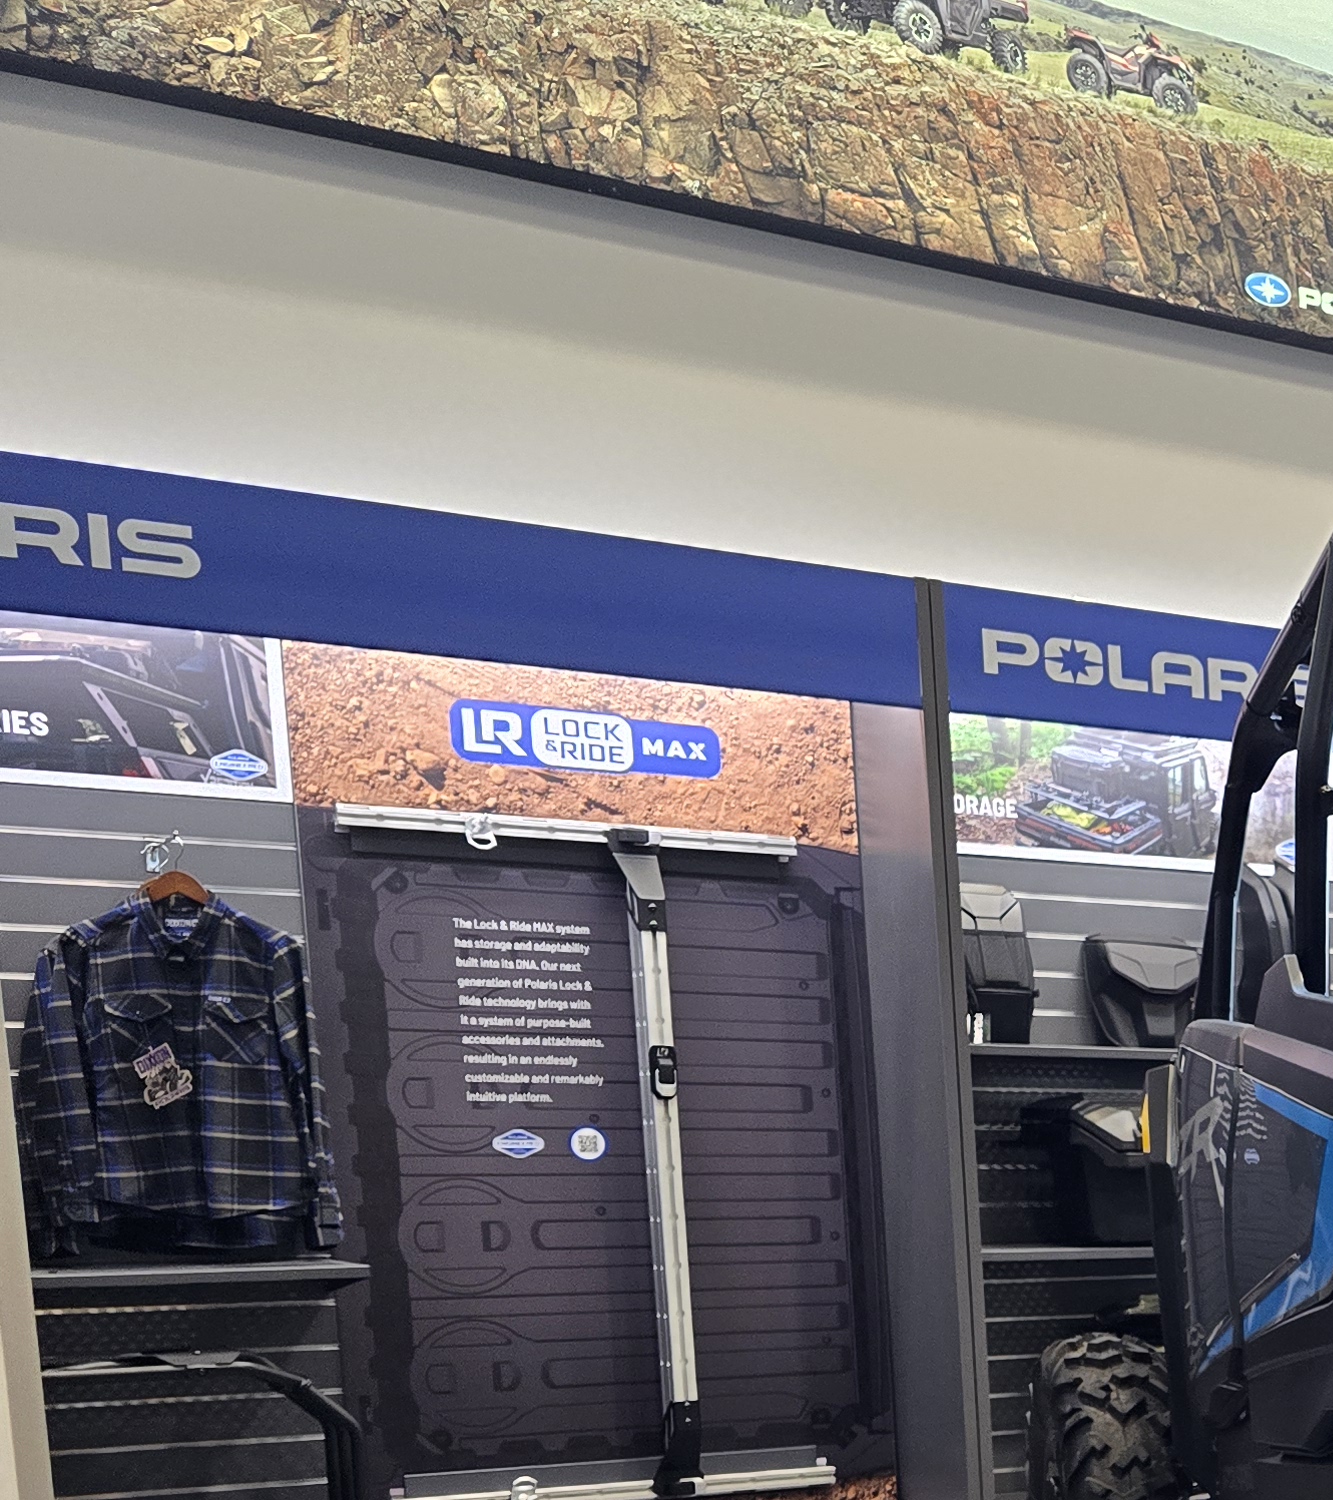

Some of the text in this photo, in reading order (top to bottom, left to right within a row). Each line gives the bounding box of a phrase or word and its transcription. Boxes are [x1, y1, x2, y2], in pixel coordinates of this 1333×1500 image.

[981, 627, 1309, 708] POLAR
[0, 708, 50, 737] IES
[543, 716, 623, 743] LOCK
[641, 736, 708, 762] MAX
[453, 917, 473, 929] The
[474, 919, 498, 930] Lock
[510, 921, 531, 932] Ride
[533, 922, 554, 933] MAX
[556, 924, 590, 935] system
[454, 937, 590, 955] has storage and adaptability
[456, 956, 582, 972] built into its DNA. Our next
[457, 977, 511, 988] generation
[525, 979, 558, 990] Polaris
[559, 980, 583, 991] Lock
[459, 995, 591, 1011] Ride technology brings with
[478, 1016, 513, 1027] system
[527, 1017, 591, 1029] purpose-built
[462, 1034, 521, 1045] accessories
[522, 1036, 540, 1046] and
[464, 1053, 507, 1066] resulting
[534, 1055, 578, 1067] endlessly
[465, 1073, 604, 1086] customizable and remarkably
[466, 1091, 553, 1103] intuitive platform.
